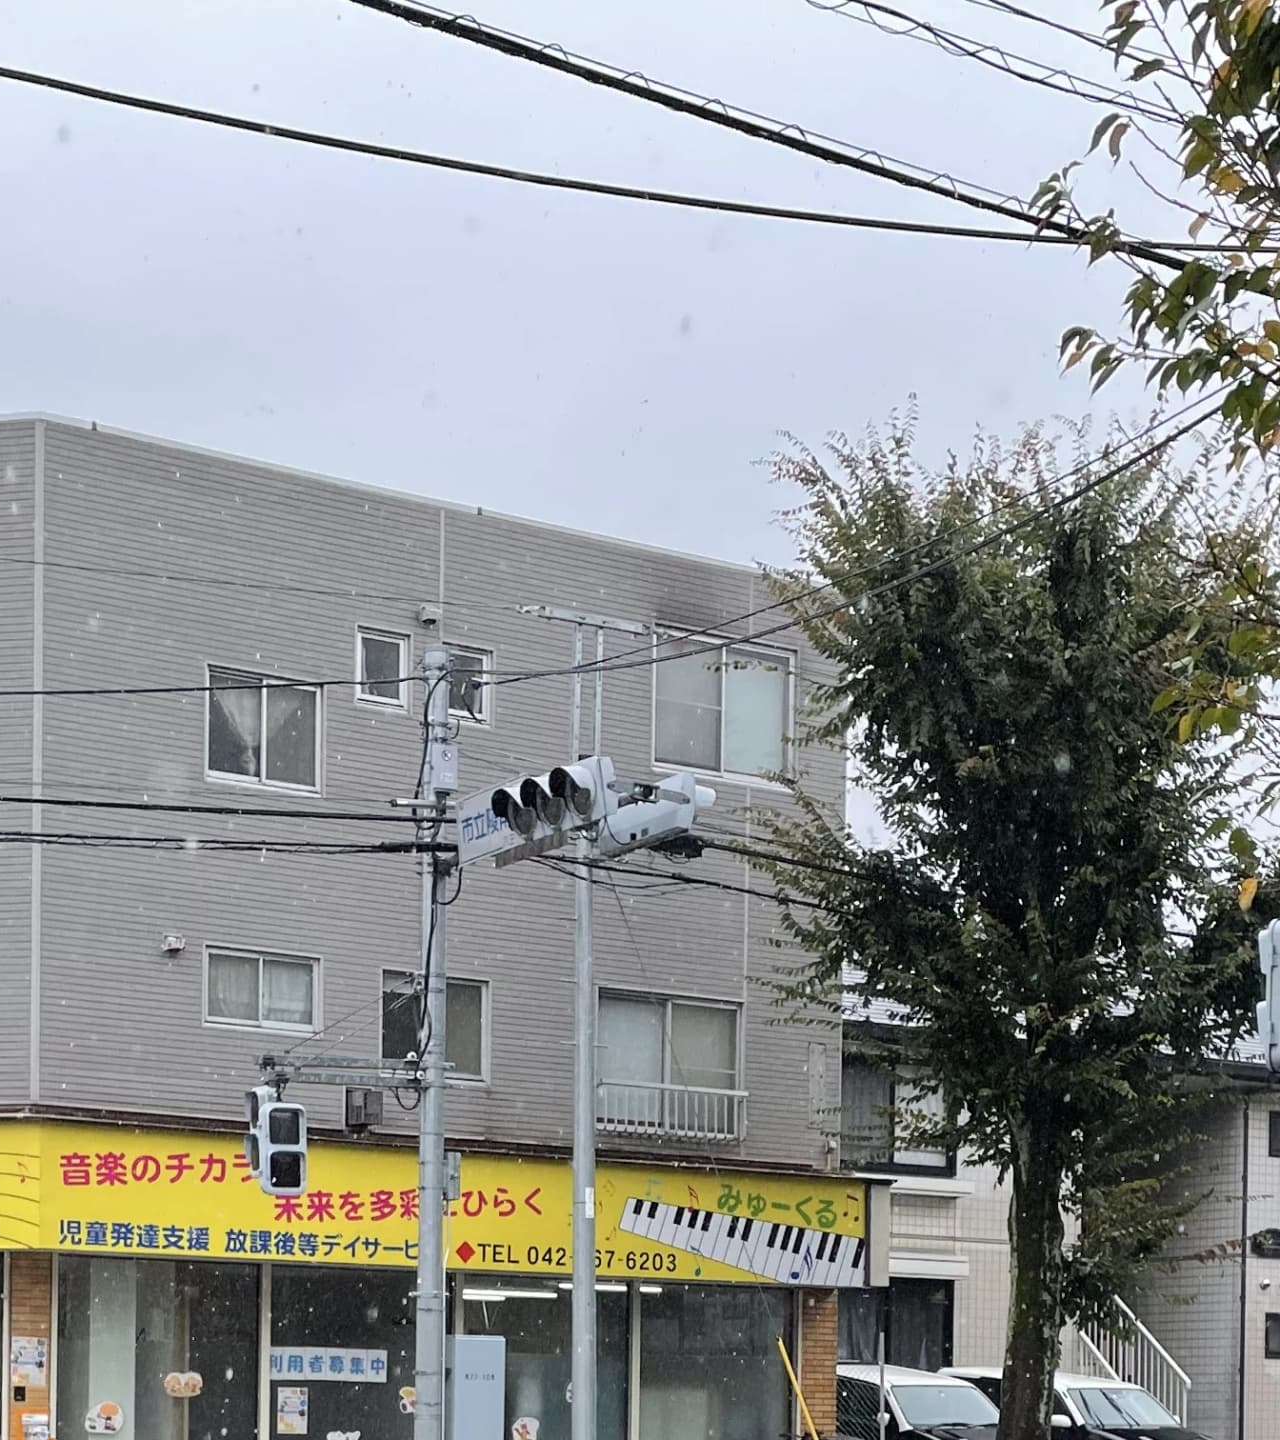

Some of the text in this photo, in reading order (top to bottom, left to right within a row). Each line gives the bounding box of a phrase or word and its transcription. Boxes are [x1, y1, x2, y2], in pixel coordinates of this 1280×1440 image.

[717, 1183, 839, 1229] みゅーくる
[59, 1219, 211, 1252] 児童発達支援
[477, 1243, 678, 1273] TEL 042-67-6203
